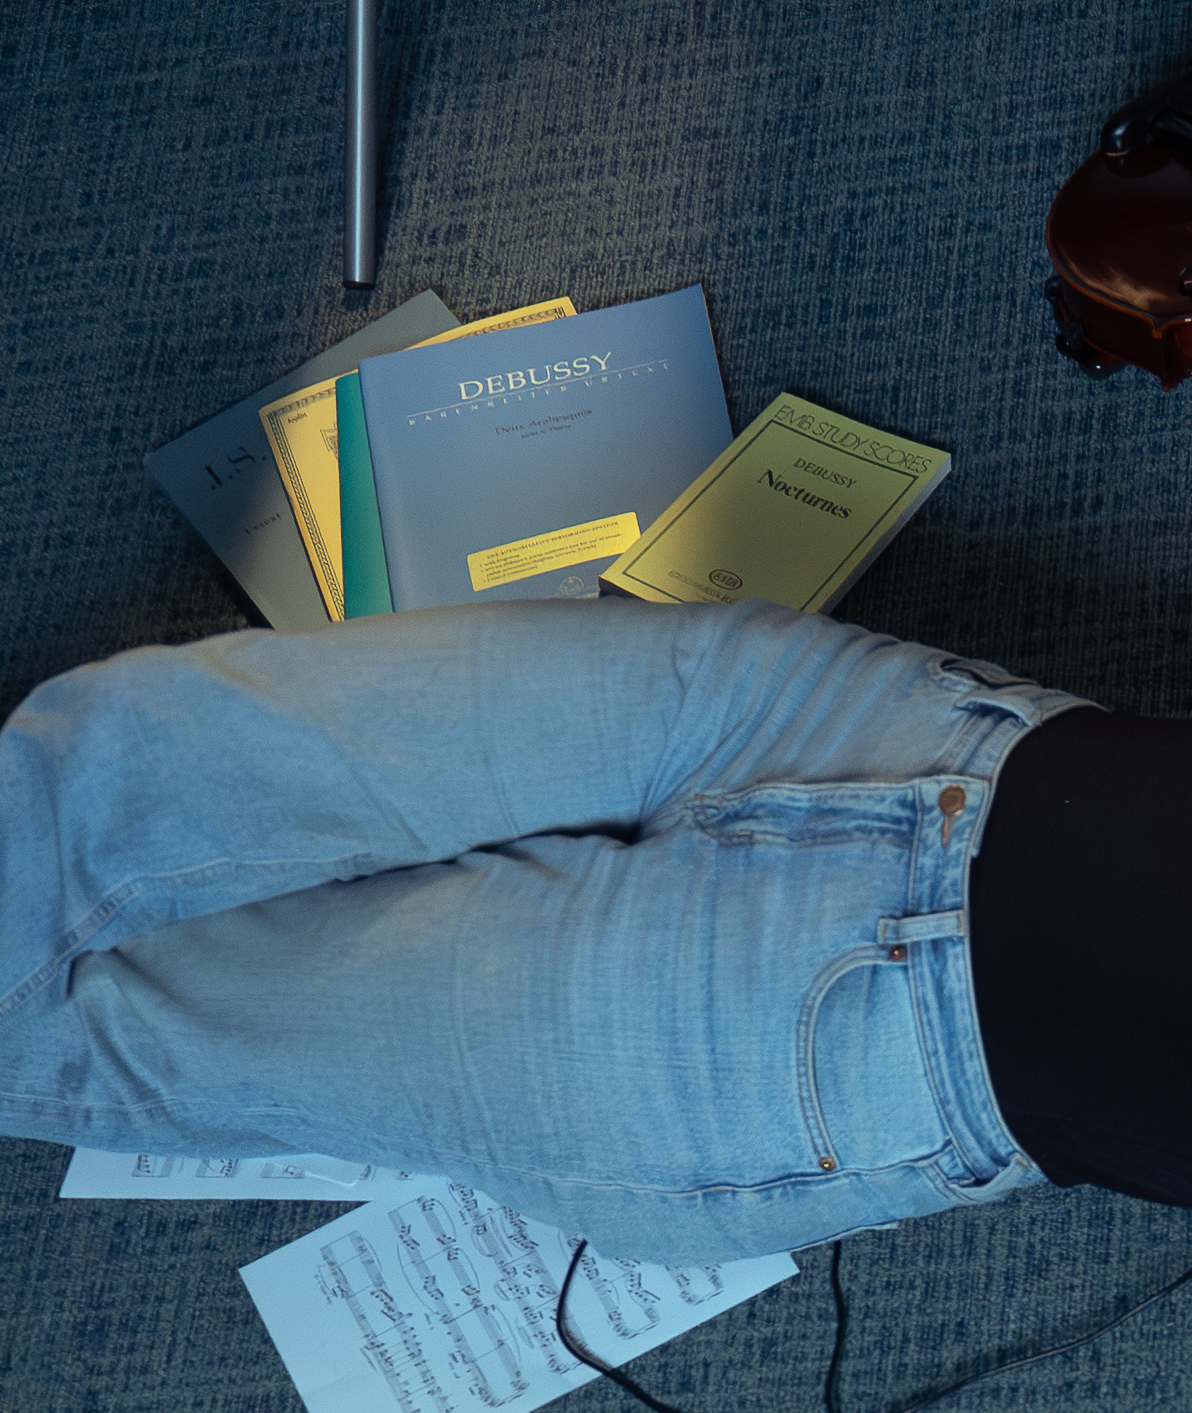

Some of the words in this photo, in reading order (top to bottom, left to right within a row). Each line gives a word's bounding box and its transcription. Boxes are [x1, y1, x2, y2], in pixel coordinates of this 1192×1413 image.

[457, 351, 613, 401] DEBUSSY
[774, 404, 815, 431] EMB
[812, 421, 869, 451] STUDY
[863, 441, 932, 474] SCORES
[756, 468, 853, 519] Nocturnes
[793, 457, 858, 489] DEBUSSY
